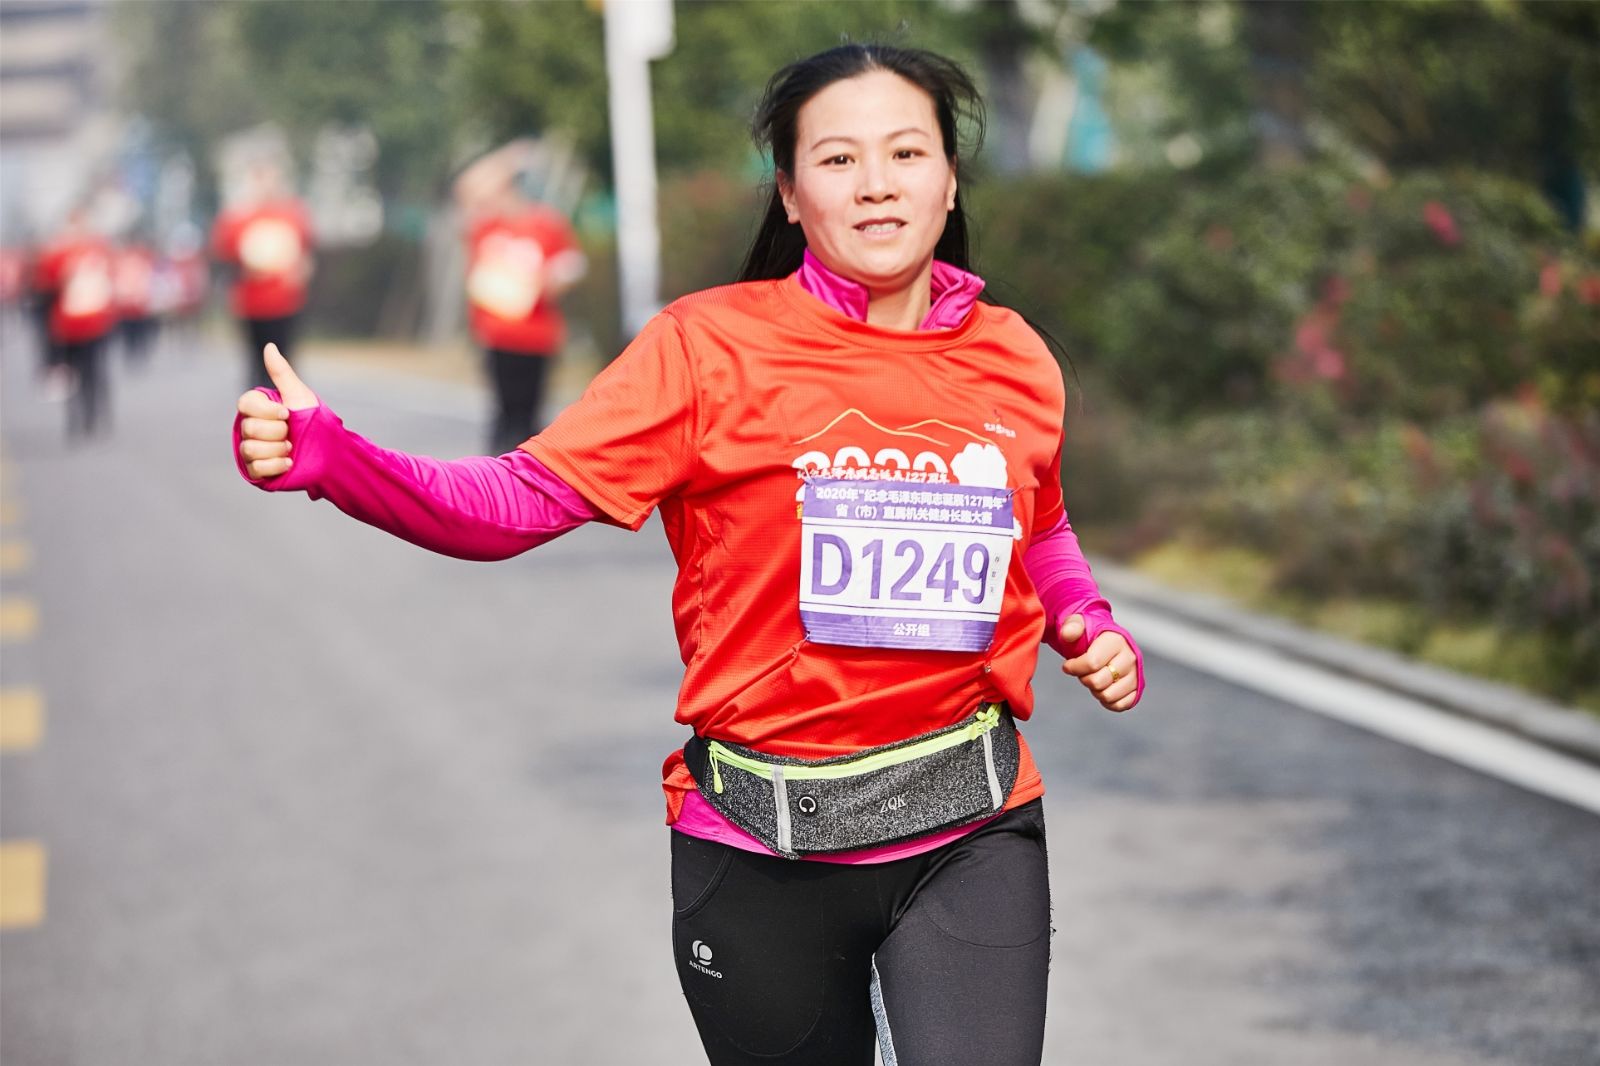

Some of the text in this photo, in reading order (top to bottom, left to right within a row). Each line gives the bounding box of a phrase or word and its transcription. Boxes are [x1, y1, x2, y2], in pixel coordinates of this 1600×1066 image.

[811, 533, 990, 605] D1249
[892, 622, 930, 637] 公开组
[689, 960, 723, 979] ARTENGO
